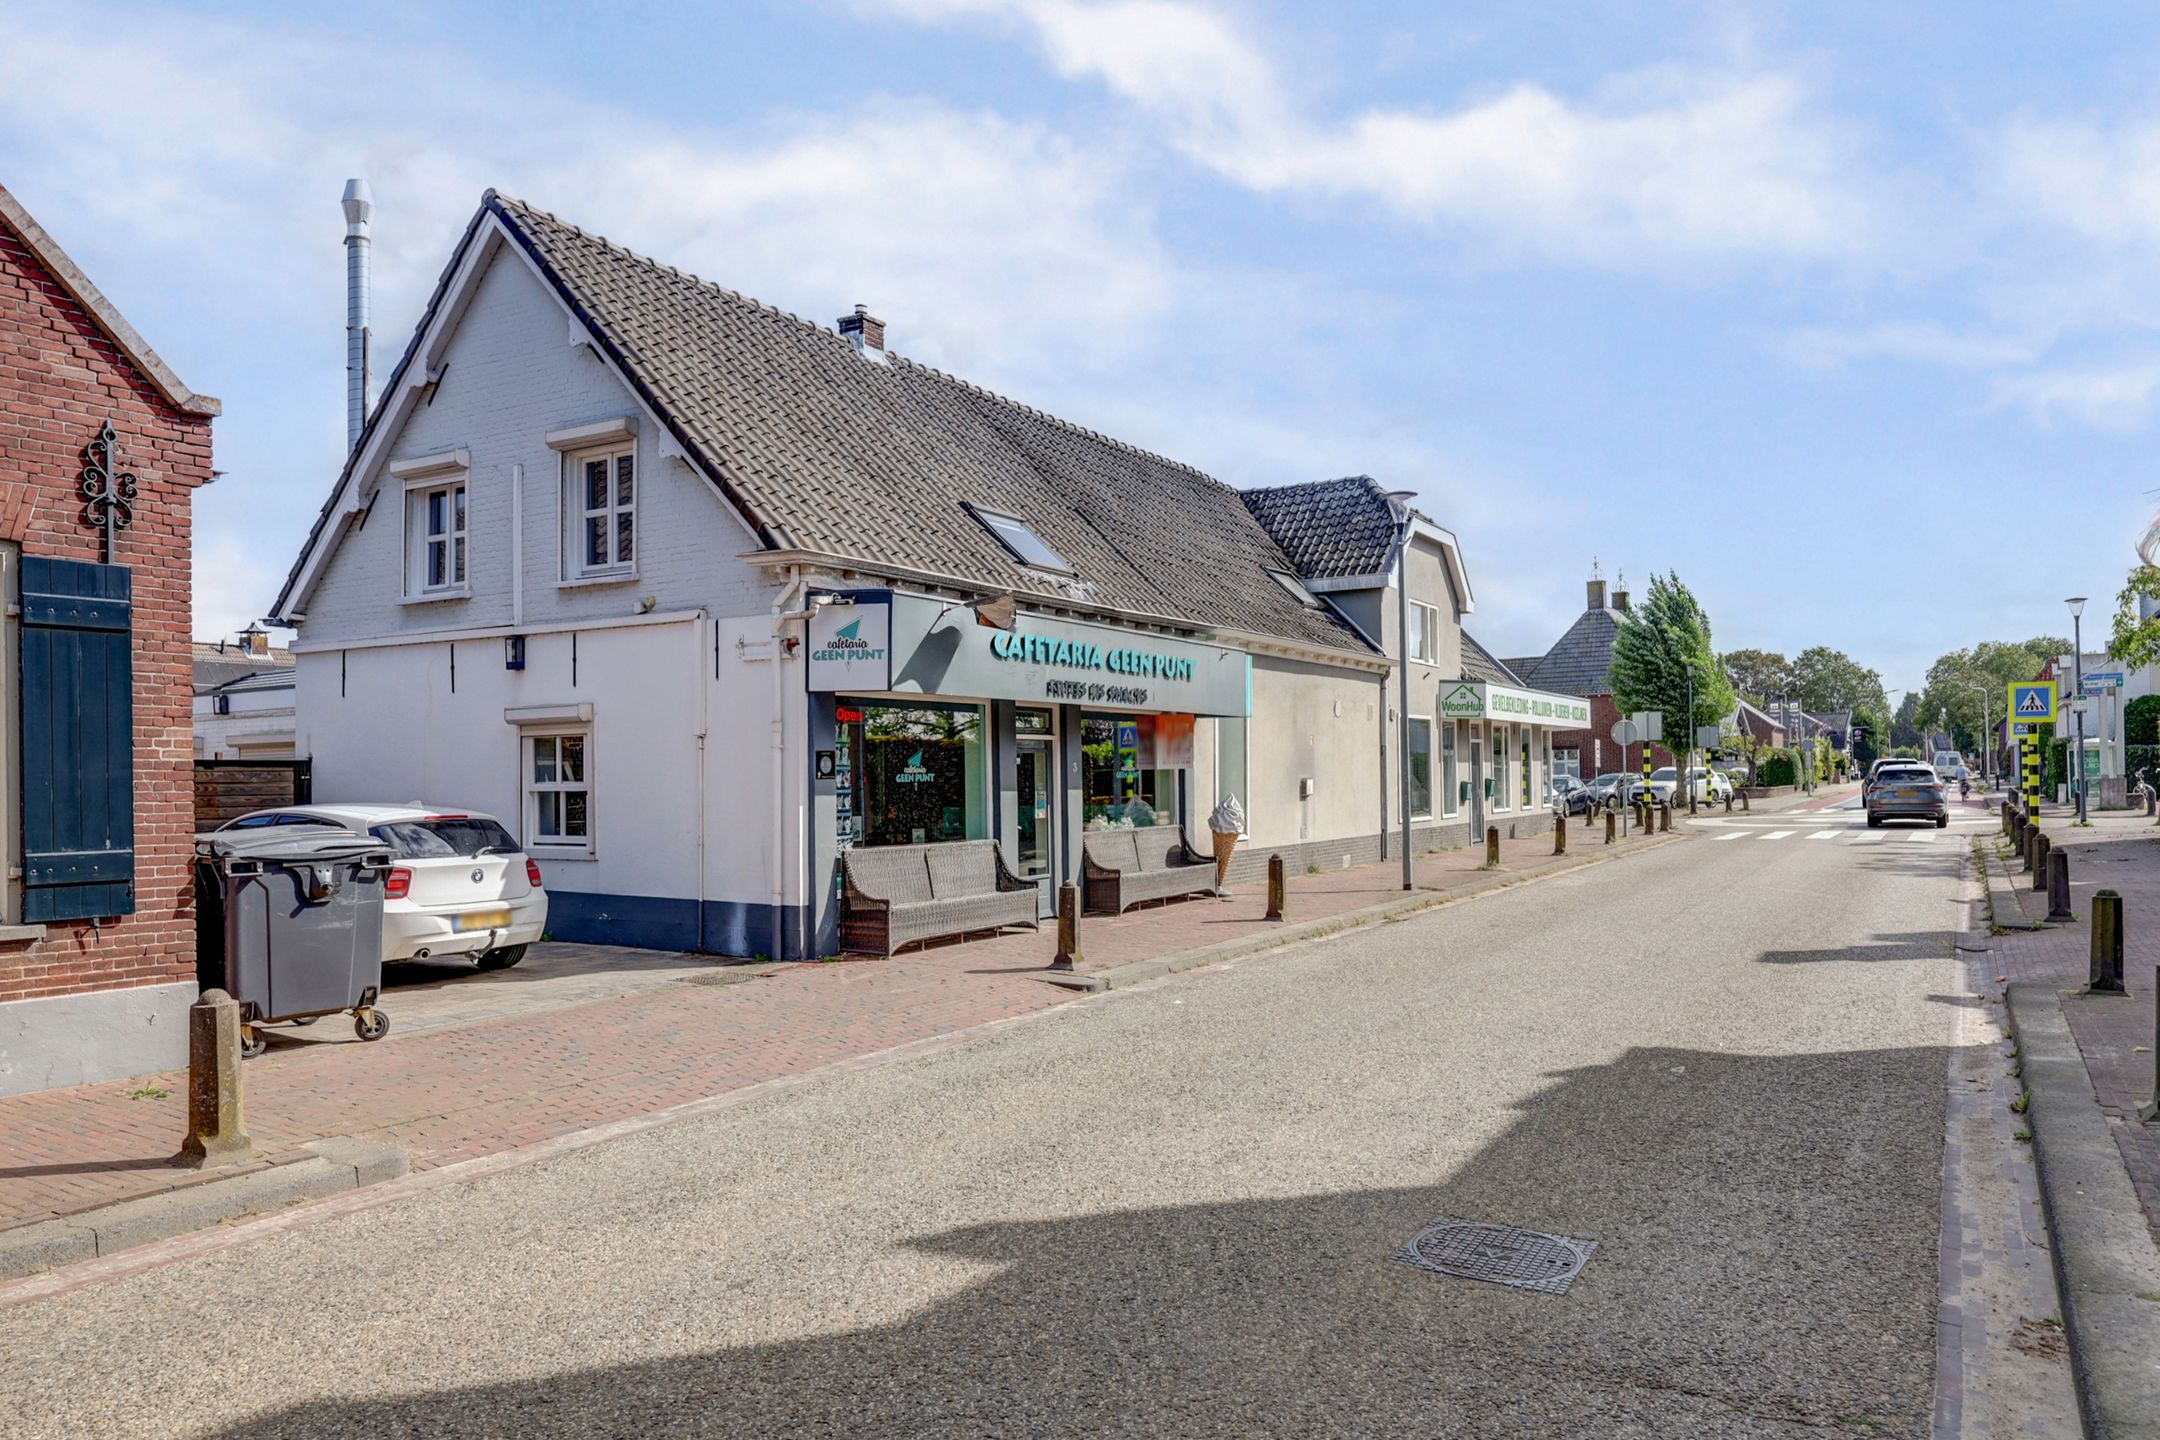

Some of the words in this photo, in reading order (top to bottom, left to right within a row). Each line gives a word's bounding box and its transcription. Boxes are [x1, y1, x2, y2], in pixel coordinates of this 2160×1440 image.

[827, 638, 868, 649] cafetaria
[812, 650, 845, 661] GEEN
[848, 649, 884, 660] PUNT
[991, 632, 1105, 669] CAFETARIA
[1107, 647, 1150, 675] GEEN
[1154, 653, 1199, 680] PUNT
[1442, 701, 1484, 712] WoonHub
[836, 708, 864, 723] Open
[896, 773, 914, 783] GEEN
[915, 773, 935, 782] PUNT
